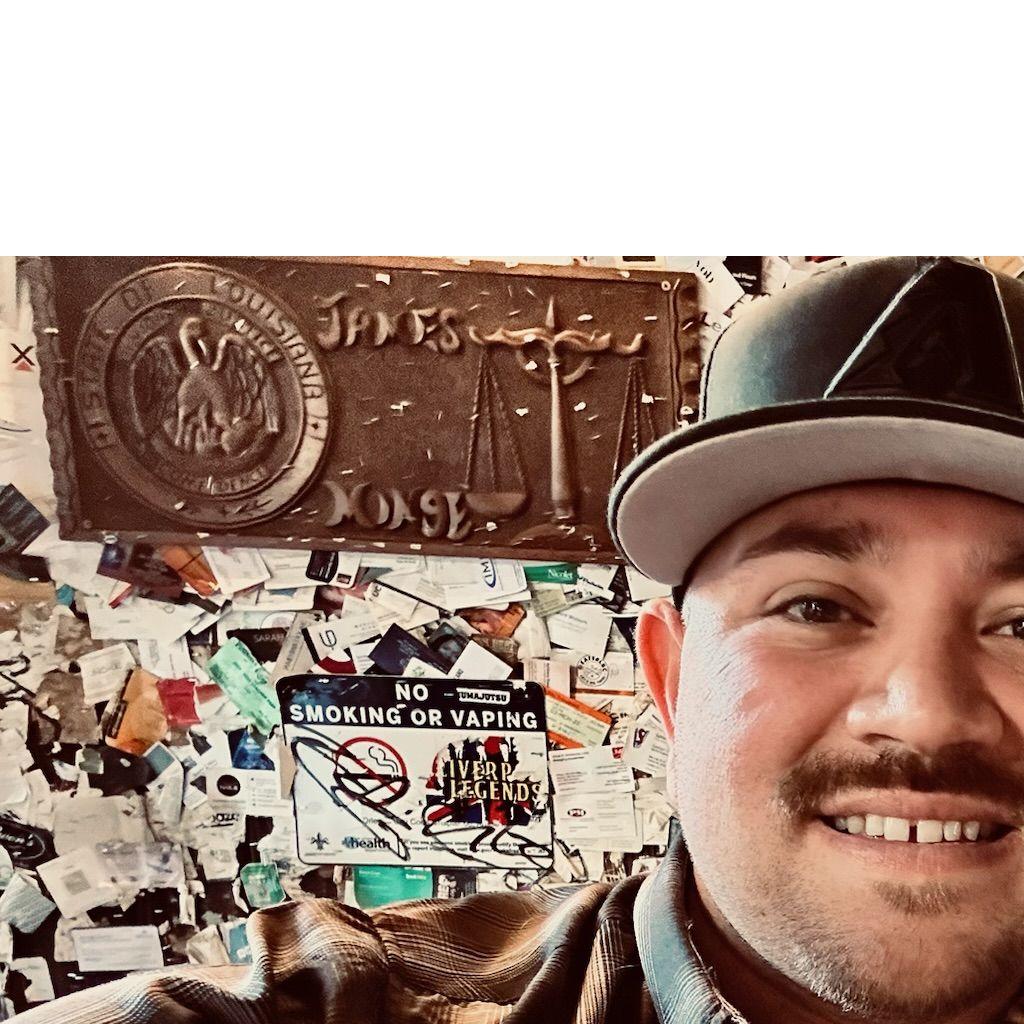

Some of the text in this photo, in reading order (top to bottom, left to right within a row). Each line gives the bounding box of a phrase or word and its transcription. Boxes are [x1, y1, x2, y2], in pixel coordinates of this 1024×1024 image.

[395, 683, 429, 701] NO
[290, 705, 401, 725] SMOKING
[411, 708, 443, 727] OR
[450, 709, 538, 730] VAPING
